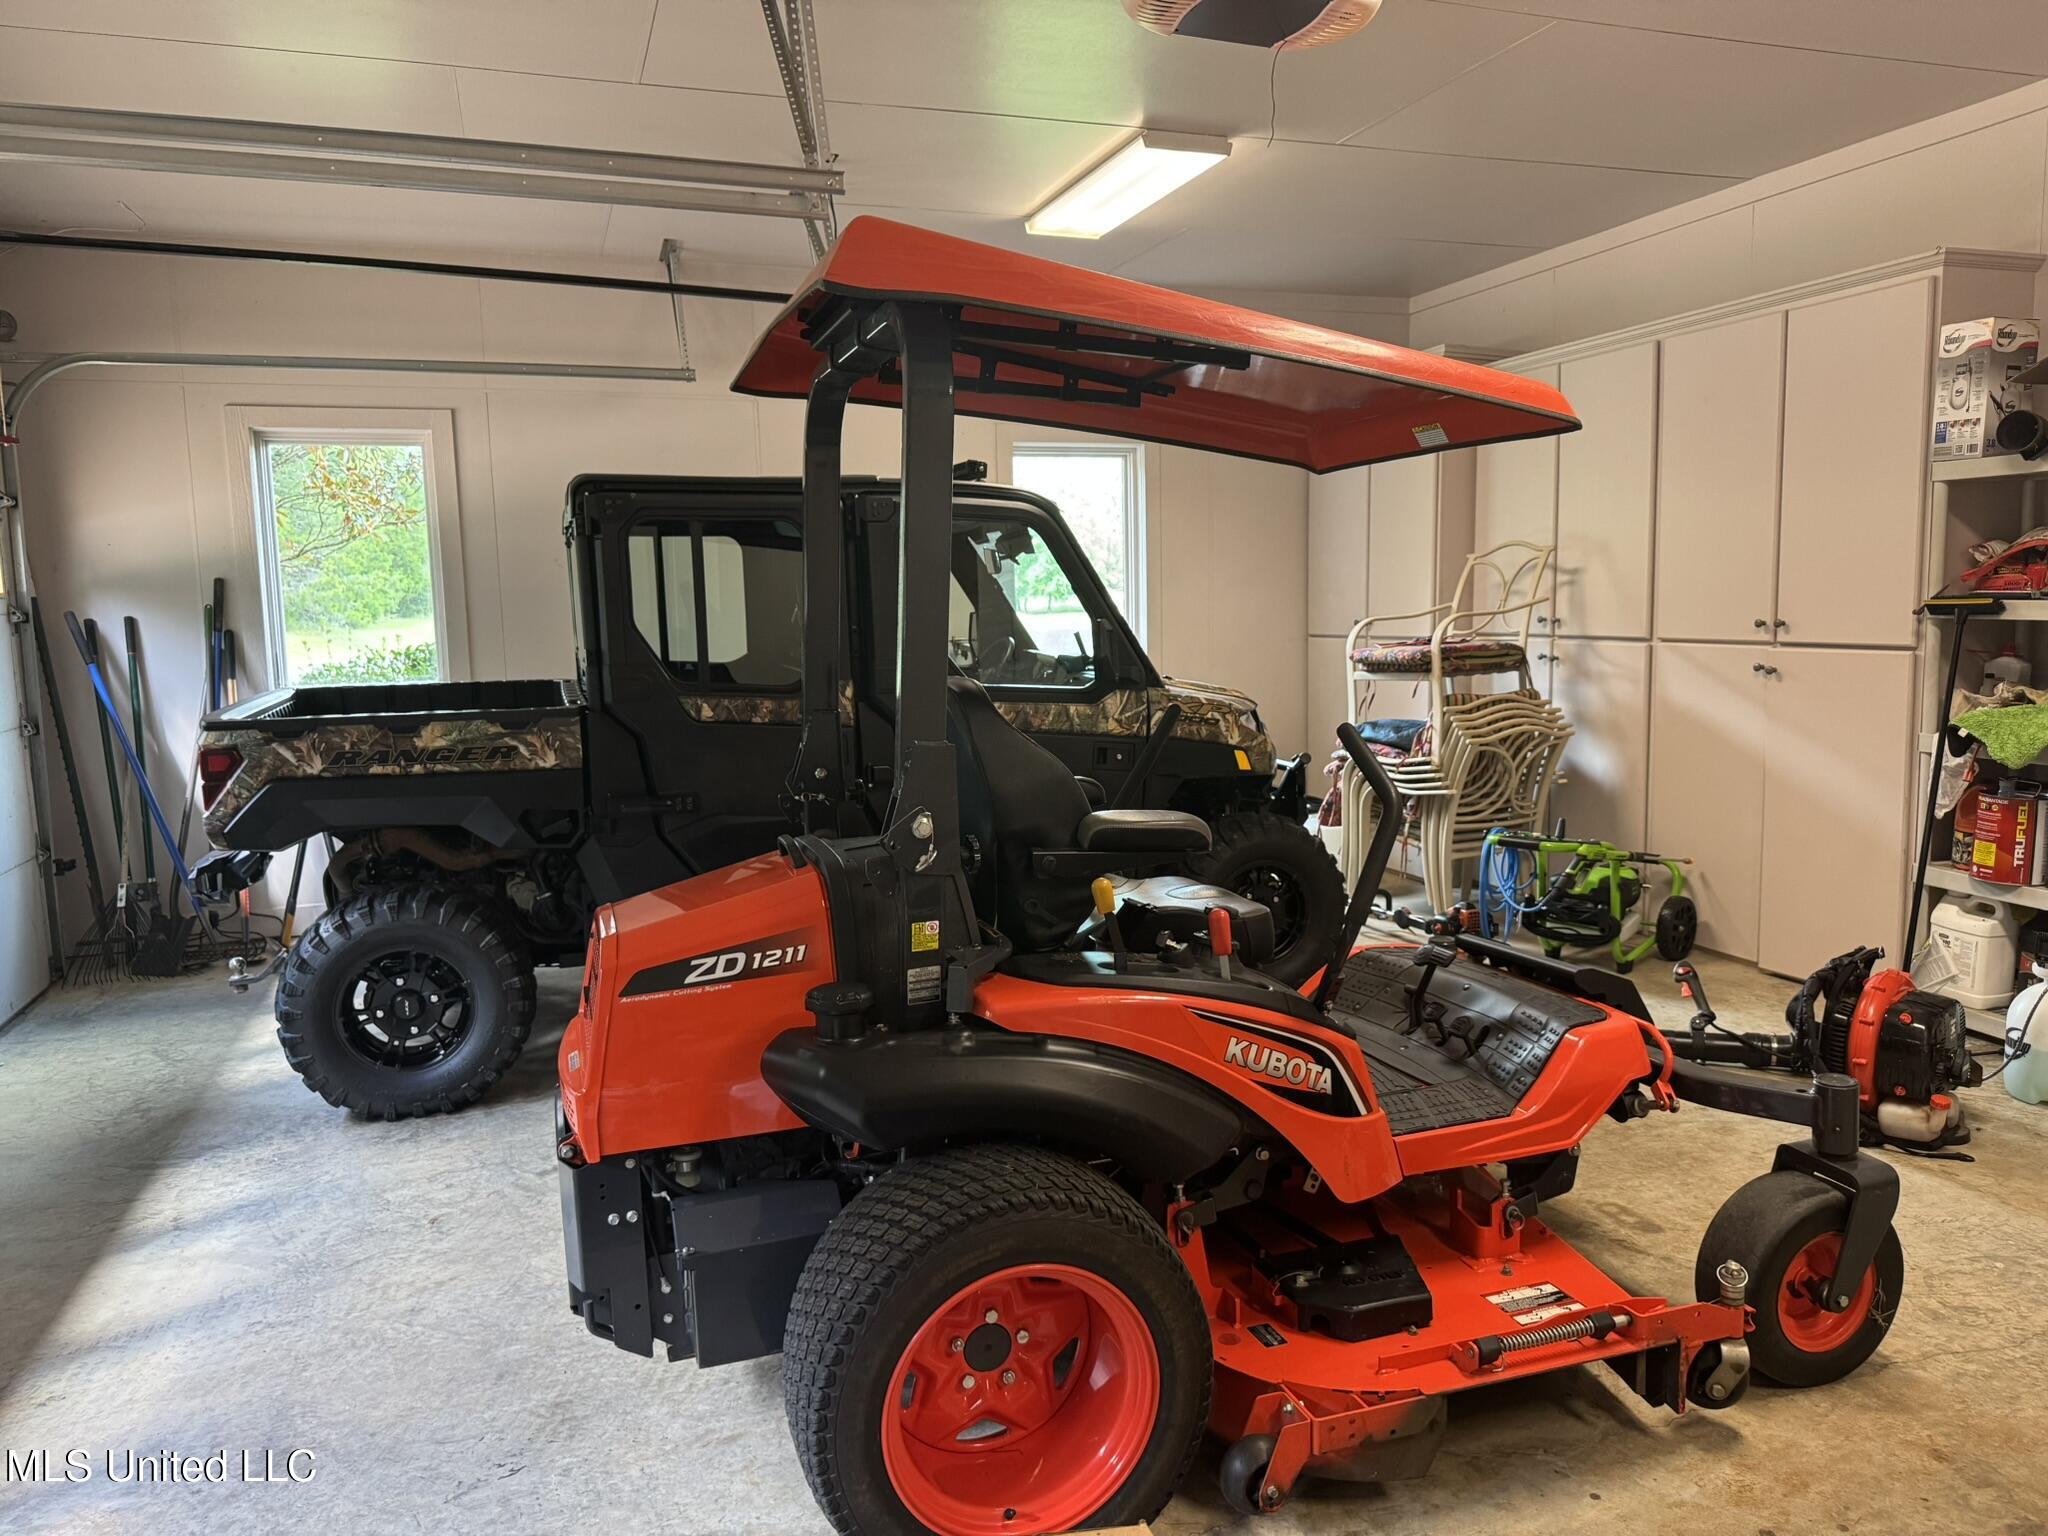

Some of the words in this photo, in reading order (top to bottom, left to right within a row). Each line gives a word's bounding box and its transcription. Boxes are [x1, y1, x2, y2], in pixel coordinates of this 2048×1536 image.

[329, 746, 519, 768] RANGER
[2013, 802, 2029, 868] TRUFUEL
[683, 951, 747, 985] ZD
[751, 944, 808, 970] 1211
[620, 991, 670, 1004] Aerodynamic
[673, 986, 703, 997] Cutting
[704, 983, 733, 994] System
[1224, 1036, 1333, 1096] KUBOTA
